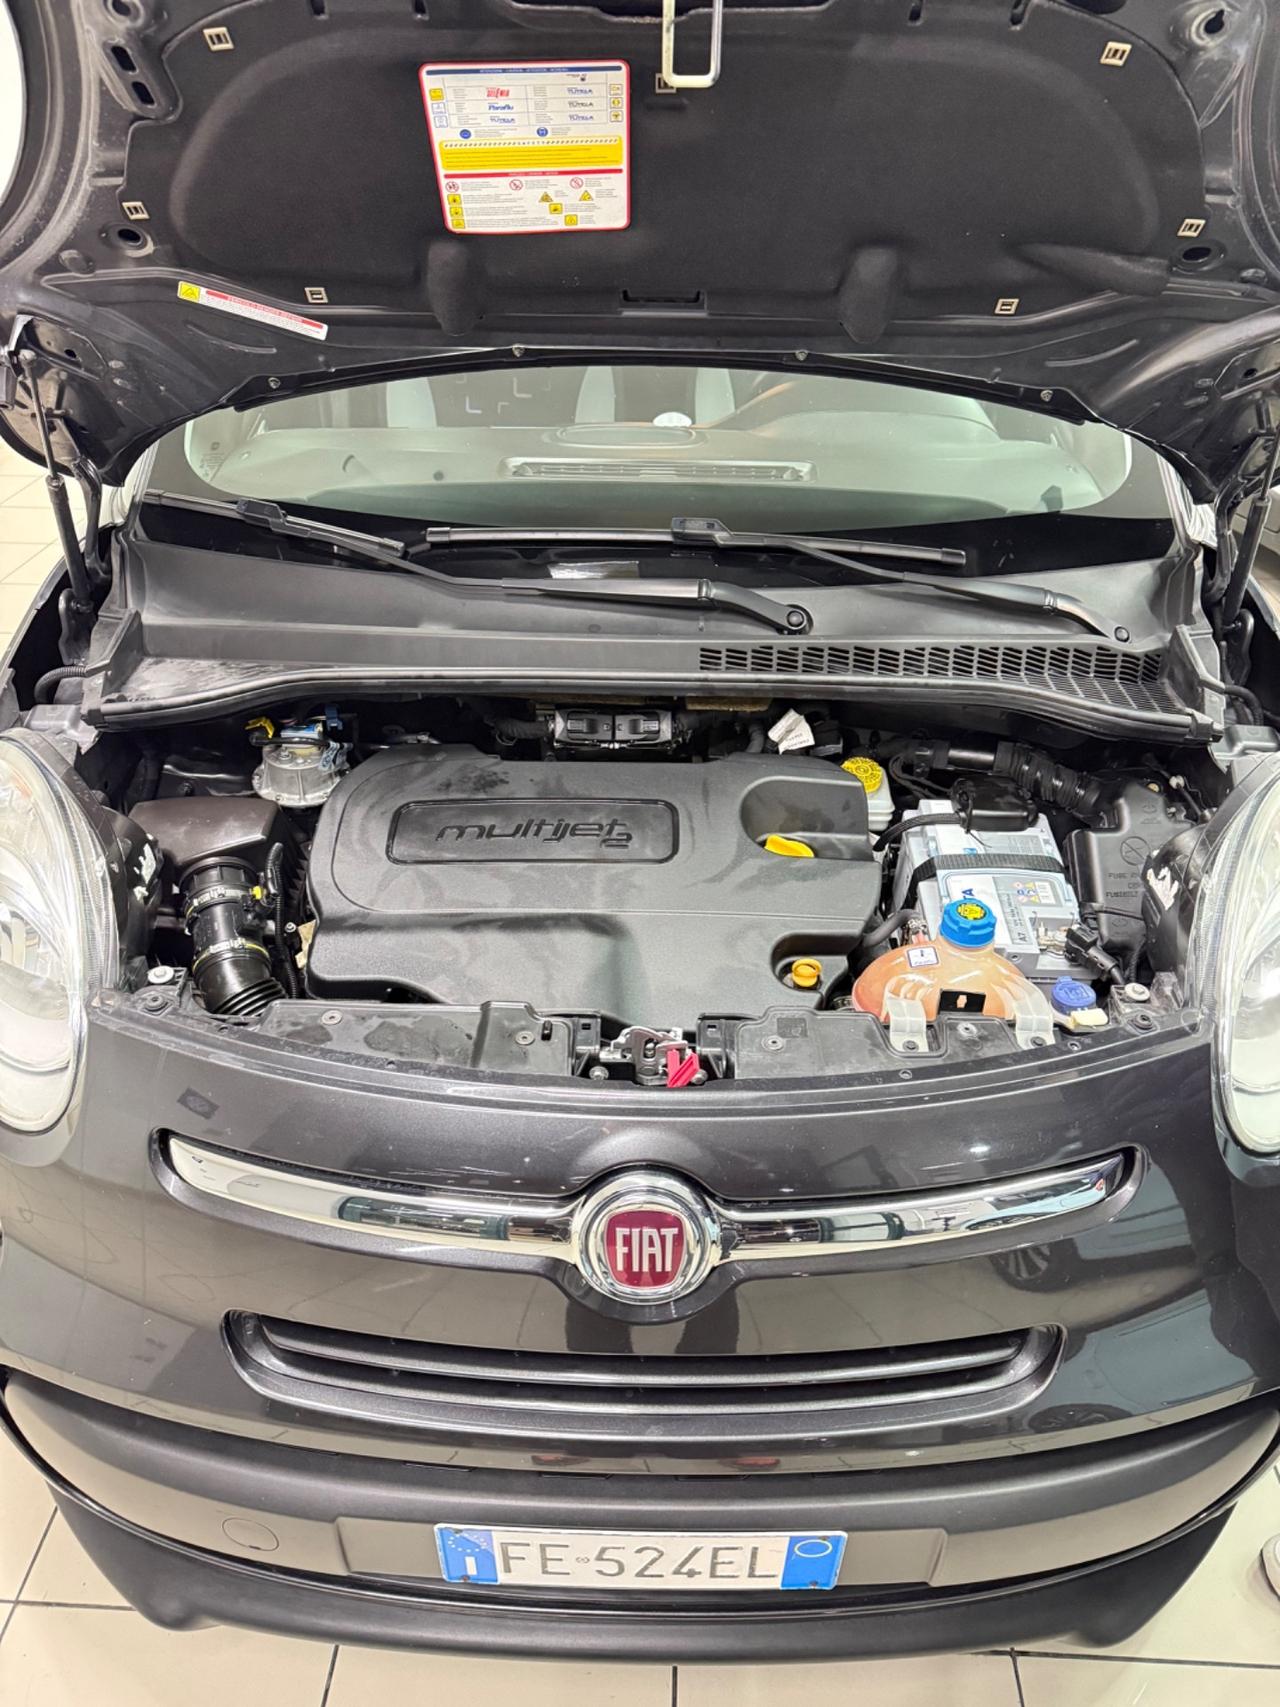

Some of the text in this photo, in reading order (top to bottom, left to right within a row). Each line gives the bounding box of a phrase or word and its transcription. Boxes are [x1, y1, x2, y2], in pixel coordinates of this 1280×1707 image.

[615, 1226, 679, 1273] FIAT
[500, 1541, 779, 1579] FE 524EL
